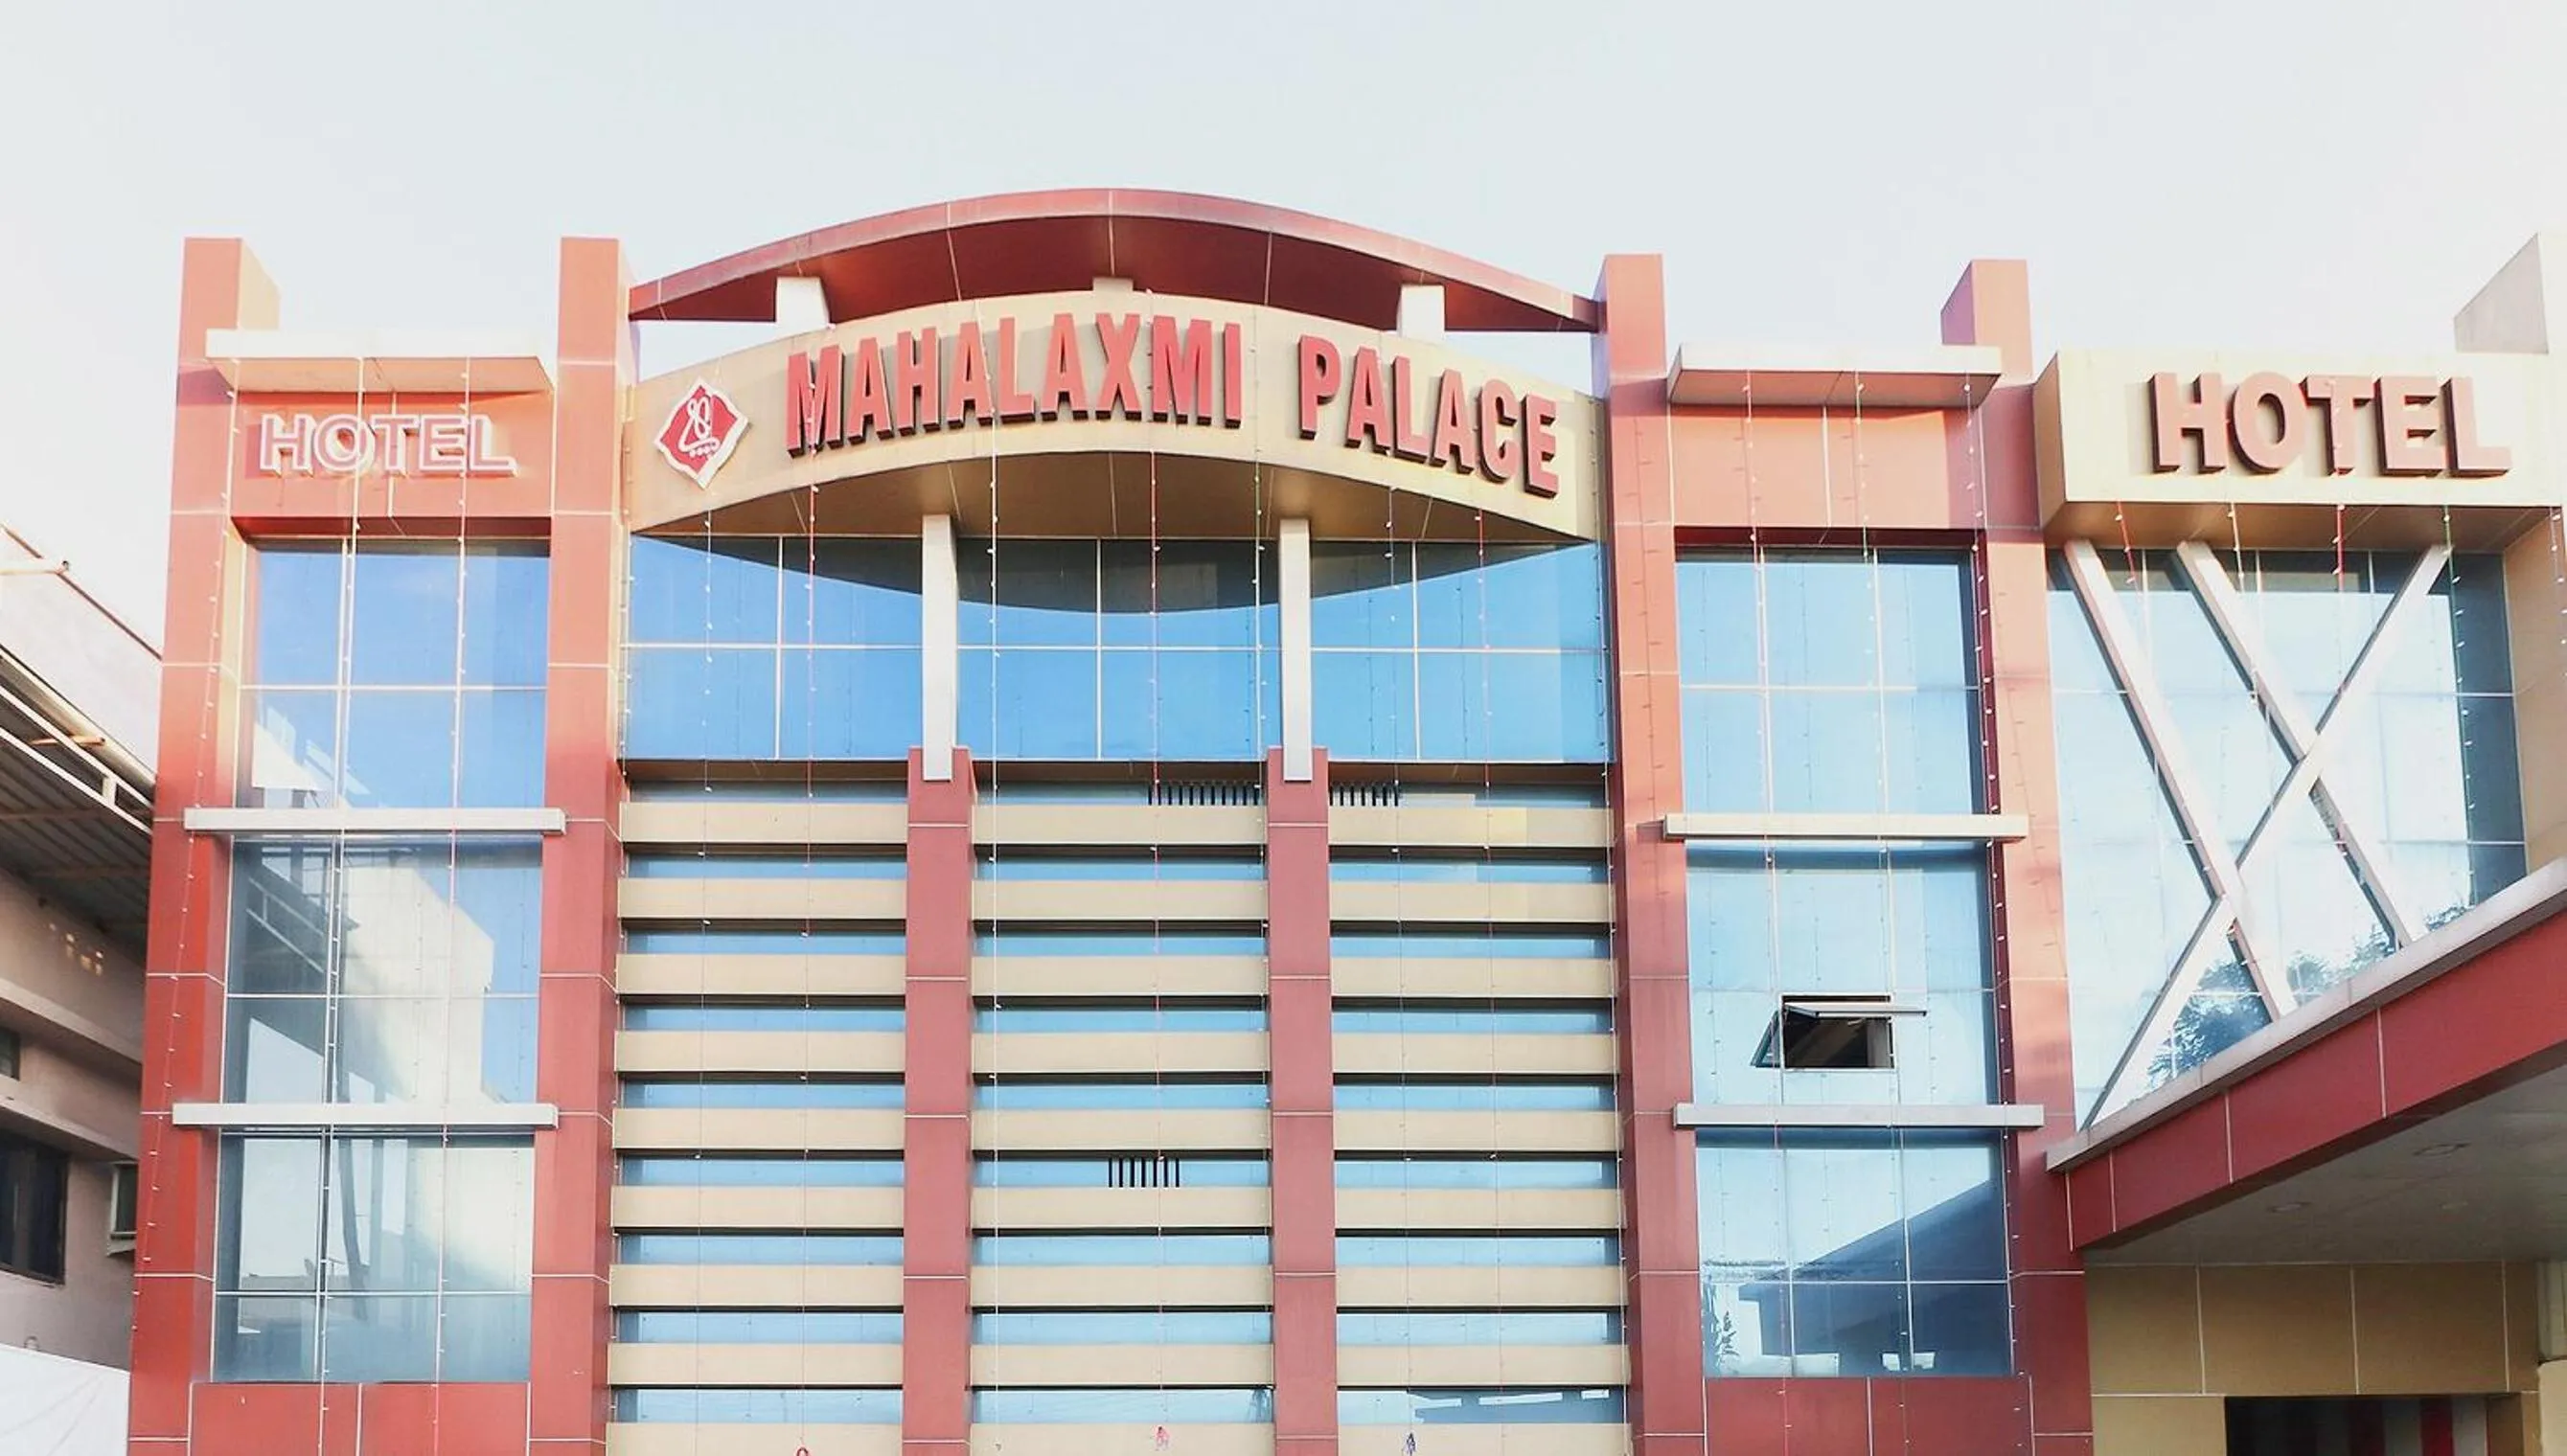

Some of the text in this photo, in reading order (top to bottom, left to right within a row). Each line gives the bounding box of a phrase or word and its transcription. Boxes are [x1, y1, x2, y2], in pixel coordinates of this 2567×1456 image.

[259, 413, 519, 476] HOTEL
[787, 312, 1558, 497] MAHALAXMI PALACE
[2149, 372, 2512, 477] HOTEL
